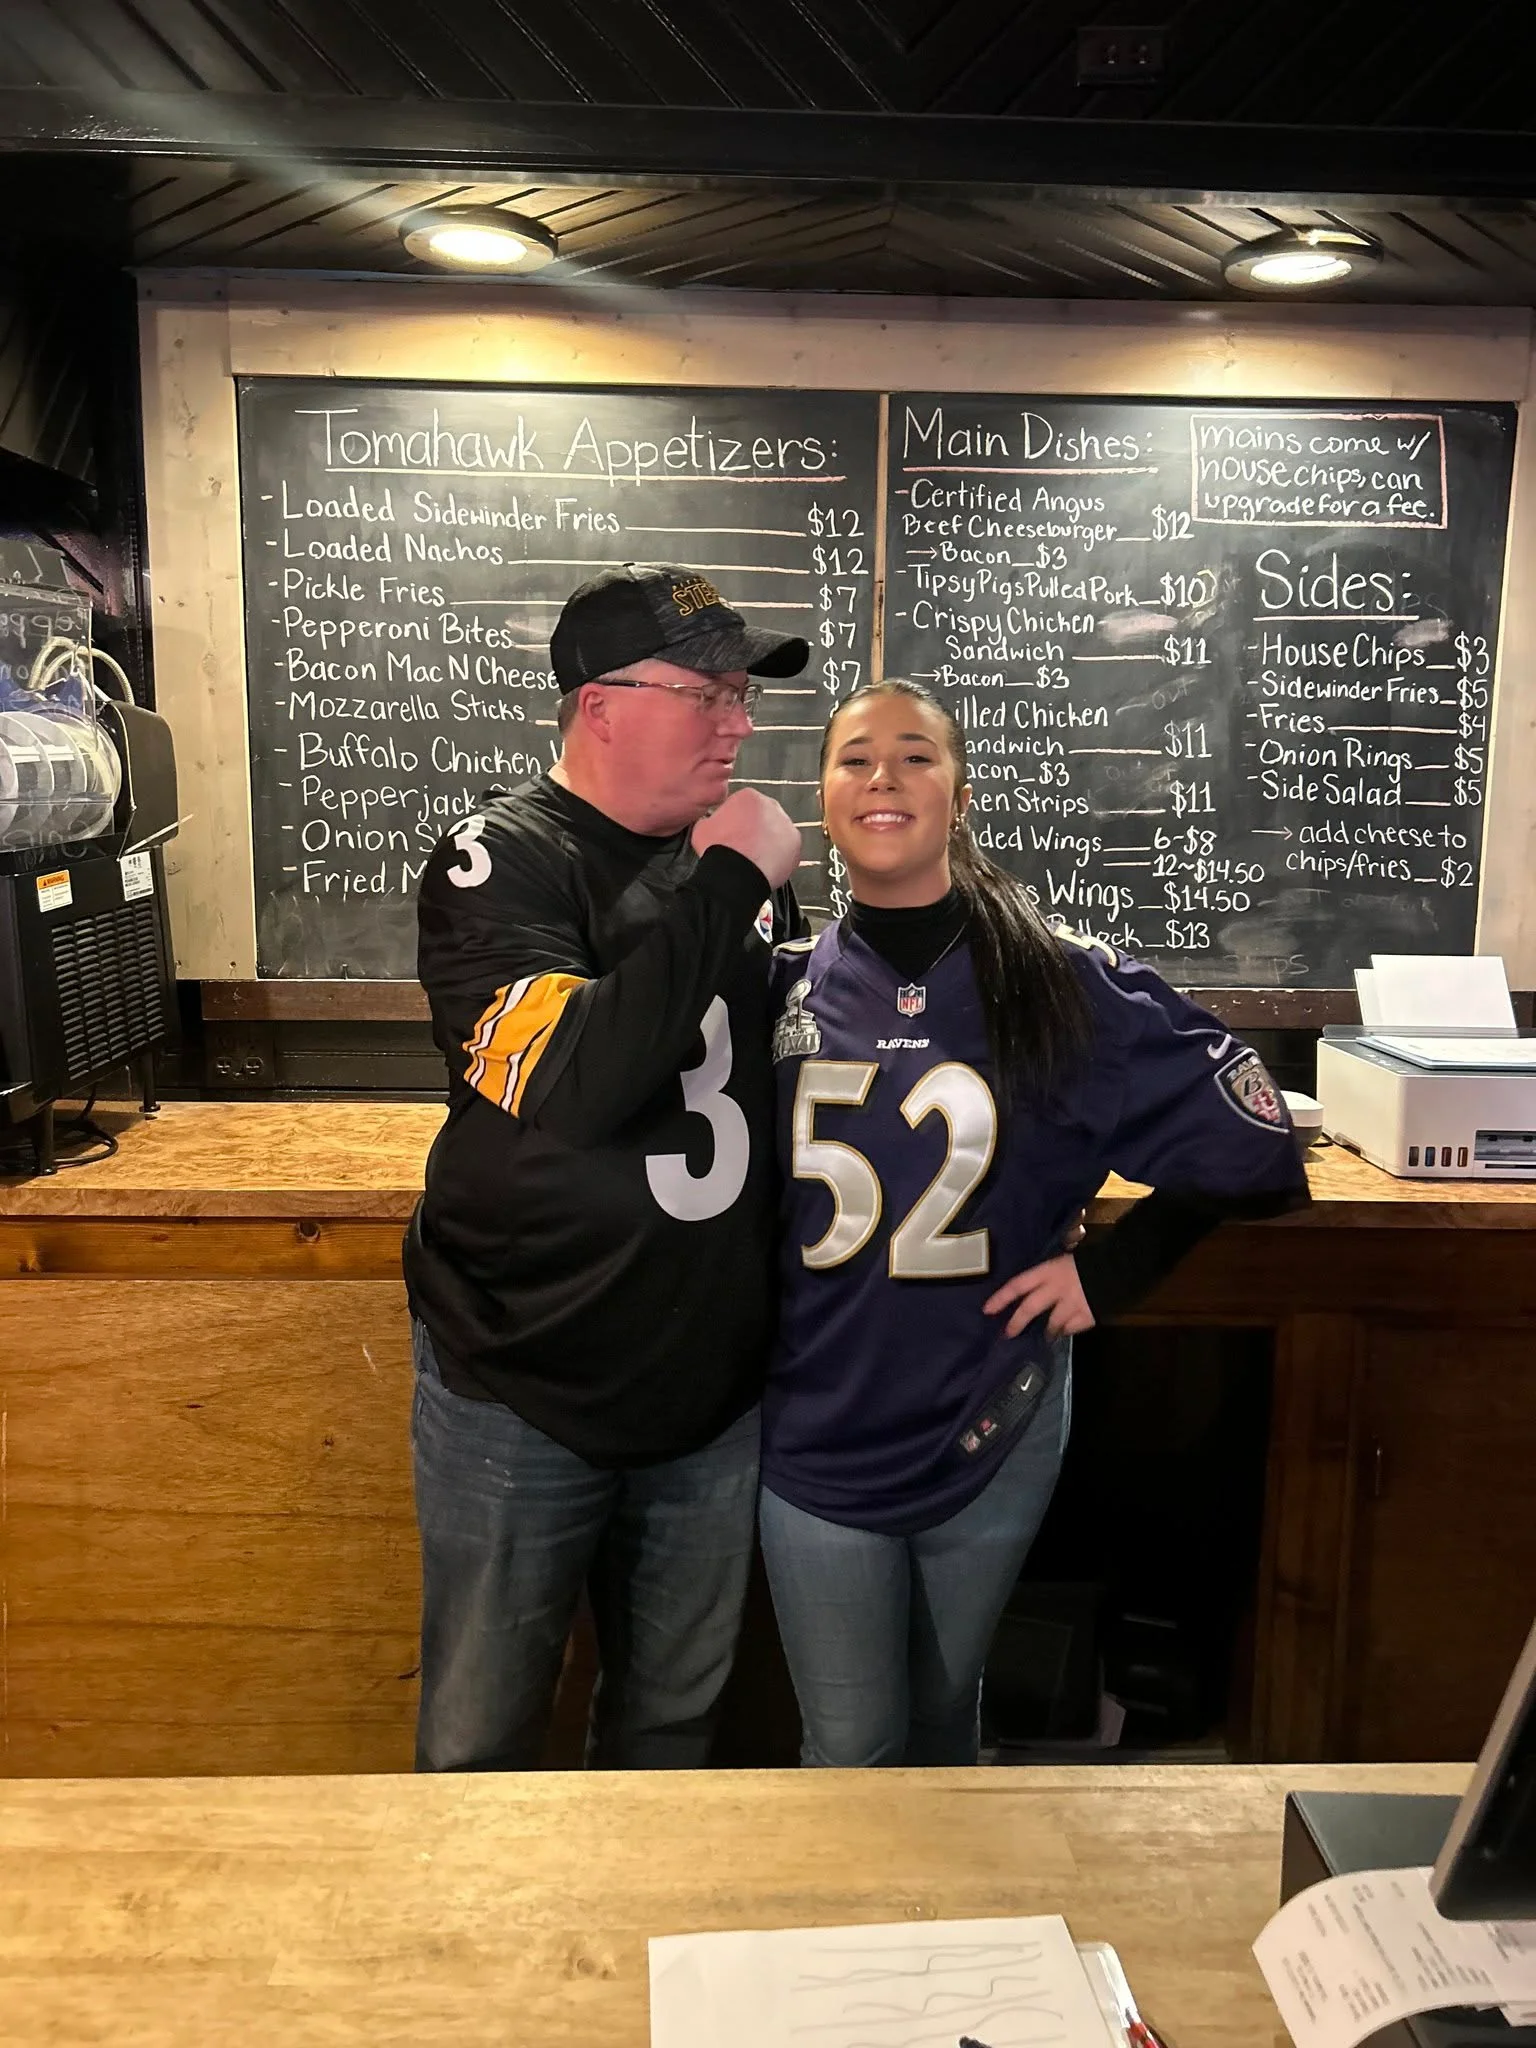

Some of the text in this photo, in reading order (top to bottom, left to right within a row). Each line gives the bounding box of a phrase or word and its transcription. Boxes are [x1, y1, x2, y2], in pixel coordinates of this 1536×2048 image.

[295, 408, 838, 487] Tomahawk Appetizers:
[904, 406, 1153, 462] Main Dishes:
[1309, 435, 1389, 455] come
[1397, 431, 1431, 461] w/
[1200, 456, 1423, 493] house chips, can
[282, 480, 864, 538] Loaded Sidewinder Fries $12
[911, 478, 1105, 523] Certified Angus
[1204, 493, 1435, 521] upgrade for a fee.
[903, 504, 1195, 552] Beef Cheeseburger $12
[284, 528, 869, 576] Loaded Nachos $12
[940, 541, 1068, 570] Bacon $3
[284, 568, 856, 614] Pickle Fries $7
[1089, 576, 1139, 606] Pork
[1160, 572, 1206, 608] $10
[1255, 549, 1412, 612] Sides:
[283, 606, 856, 649] Pepperoni Bites $7
[913, 600, 1094, 645] Crispy Chicken
[945, 634, 1212, 667] Sandwich $11
[1262, 631, 1490, 675] House Chips $3
[286, 648, 376, 682] Bacon
[387, 651, 443, 684] Mac
[449, 653, 469, 681] N
[823, 657, 861, 695] $7
[940, 665, 1070, 689] Bacon $3
[1261, 669, 1489, 710] Sidewinder Fries $5
[289, 689, 525, 722] Mozzarella Sticks
[955, 695, 1109, 730] illed Chicken
[1259, 703, 1486, 742] Fries $4
[298, 732, 418, 770] Buffalo
[432, 736, 541, 774] Chicken
[965, 720, 1212, 759] andwich $11
[966, 762, 1018, 781] acon
[1039, 763, 1070, 787] $3
[1259, 737, 1484, 783] Onion Rings $5
[1014, 786, 1089, 818] Strips
[1170, 780, 1216, 819] $11
[1260, 769, 1482, 807] Side Salad $5
[301, 819, 409, 852] Onion
[447, 814, 492, 889] 3
[1030, 825, 1102, 868] Wings
[1299, 820, 1467, 849] add cheese to
[303, 859, 386, 894] Fried
[1285, 850, 1473, 888] chips/fries $2
[1046, 868, 1134, 923] Wings
[1164, 880, 1250, 914] $14.50
[1165, 918, 1210, 949] $13
[901, 996, 922, 1011] NFL
[876, 1038, 930, 1050] RAVENS
[645, 994, 750, 1222] 3
[792, 1058, 997, 1279] 52
